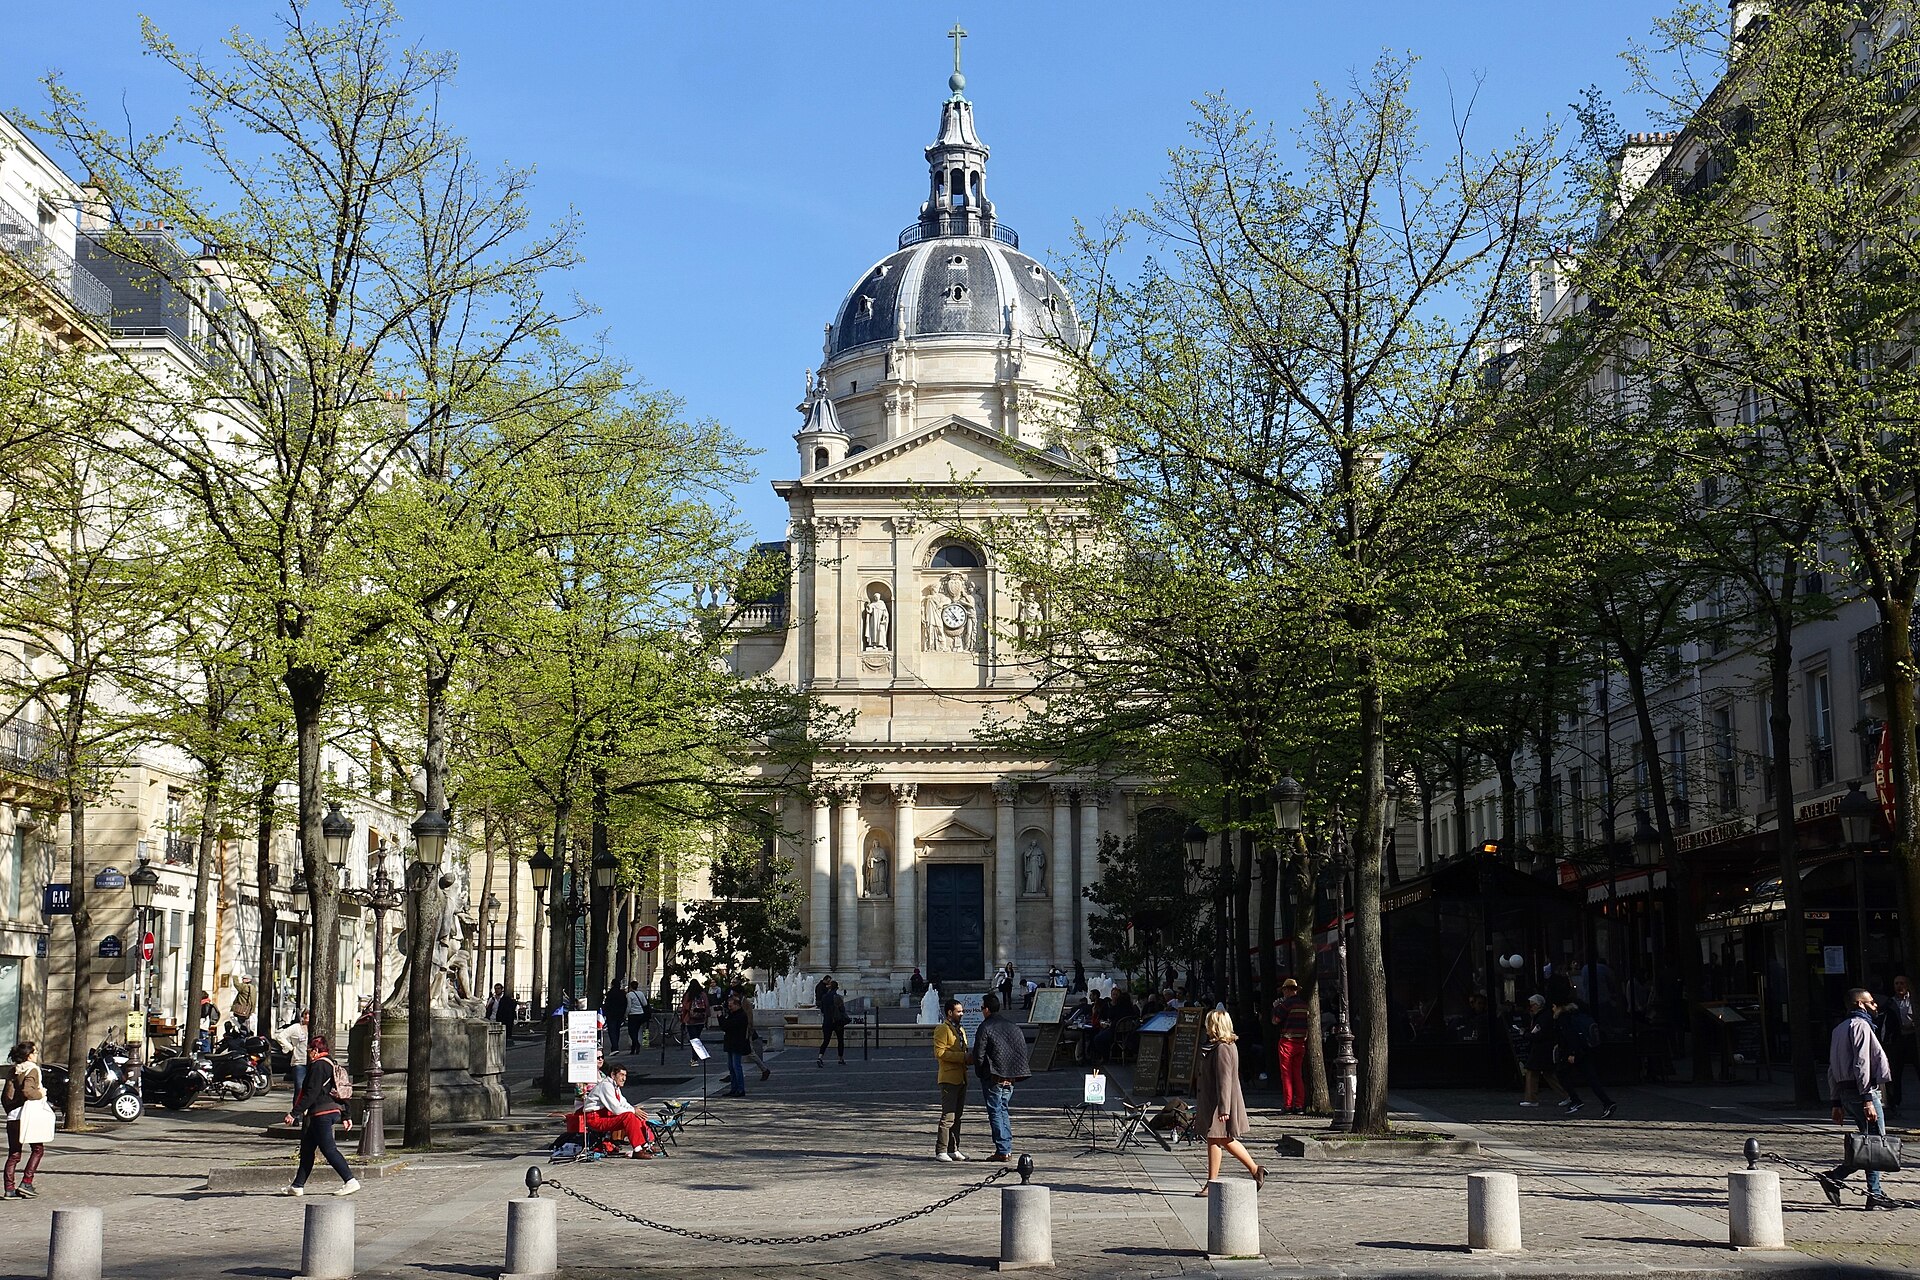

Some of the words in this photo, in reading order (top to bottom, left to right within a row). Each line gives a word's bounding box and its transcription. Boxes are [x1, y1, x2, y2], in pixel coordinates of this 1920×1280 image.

[1710, 822, 1738, 843] PATIOS
[52, 890, 70, 904] GAP
[155, 883, 180, 898] BRAIRIE
